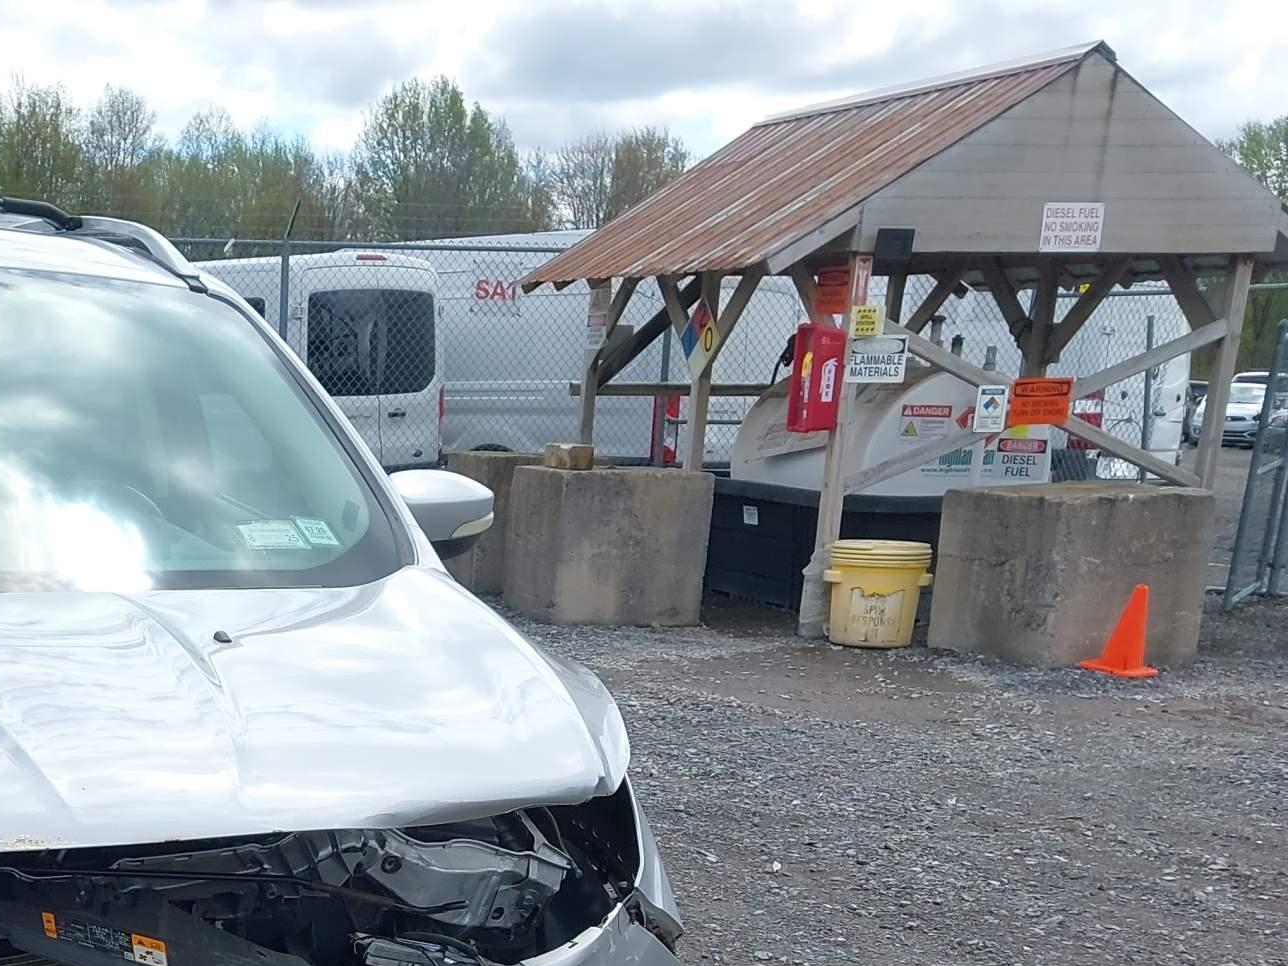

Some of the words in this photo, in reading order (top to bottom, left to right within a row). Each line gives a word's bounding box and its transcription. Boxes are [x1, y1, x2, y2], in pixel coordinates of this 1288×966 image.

[1046, 207, 1076, 219] DIESEL
[1078, 207, 1100, 219] FUEL
[1044, 221, 1057, 232] NO
[1059, 221, 1099, 232] SMOKING
[1054, 235, 1072, 246] THIS
[1073, 235, 1097, 246] AREA
[850, 355, 903, 366] FLAMMABLE
[849, 366, 899, 377] MATERIALS
[1021, 384, 1064, 394] WARNING
[913, 405, 950, 416] DANGER
[1002, 454, 1038, 466] DIESEL
[1004, 466, 1031, 477] FUEL
